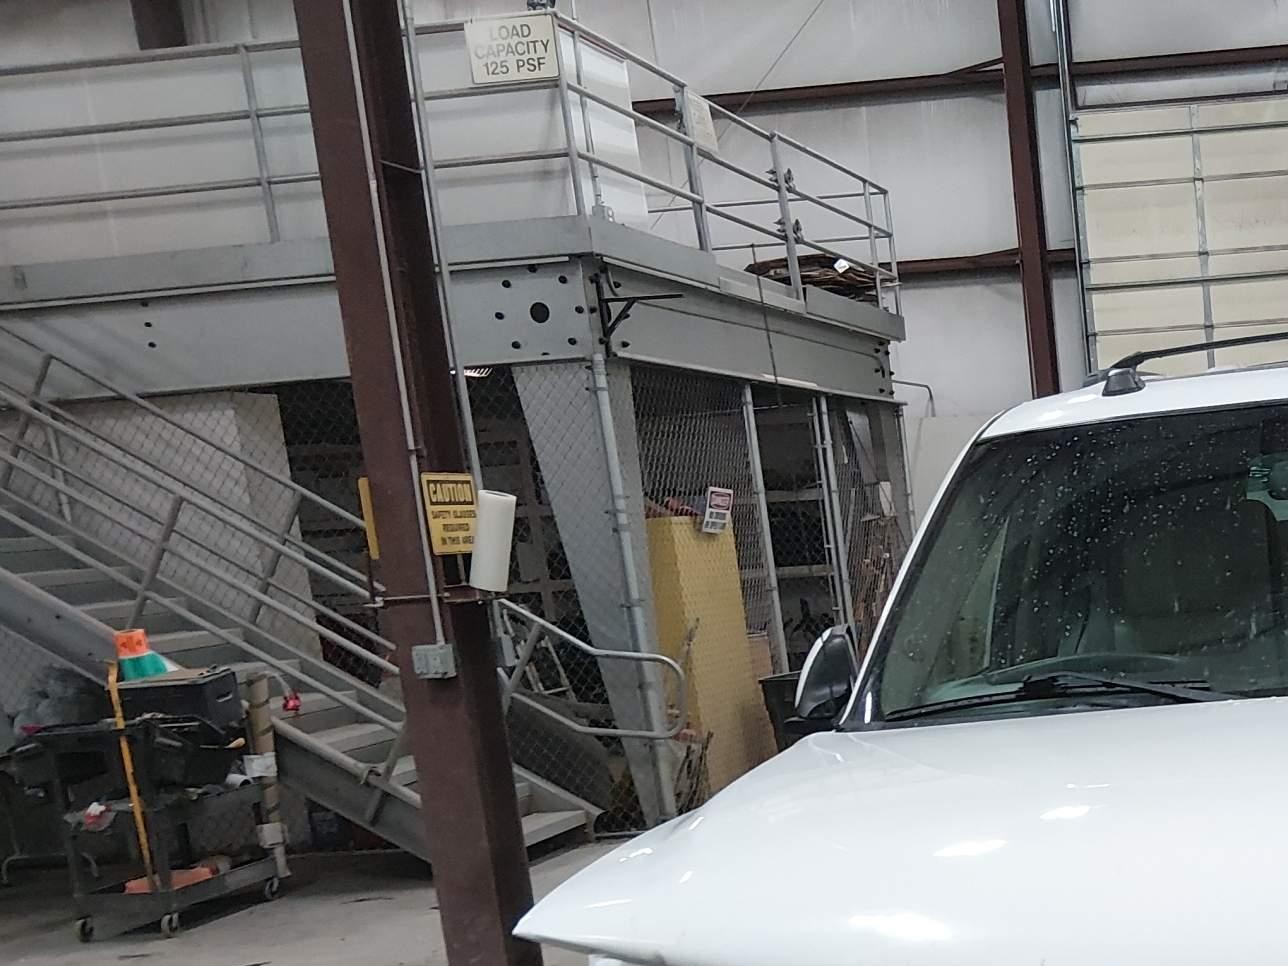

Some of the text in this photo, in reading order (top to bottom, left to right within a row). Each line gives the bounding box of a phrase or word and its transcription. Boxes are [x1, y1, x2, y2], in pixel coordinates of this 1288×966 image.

[490, 23, 531, 41] LOAD
[474, 39, 550, 60] CAPACITY
[482, 56, 546, 76] 125 PSF
[429, 483, 473, 502] CAUTION
